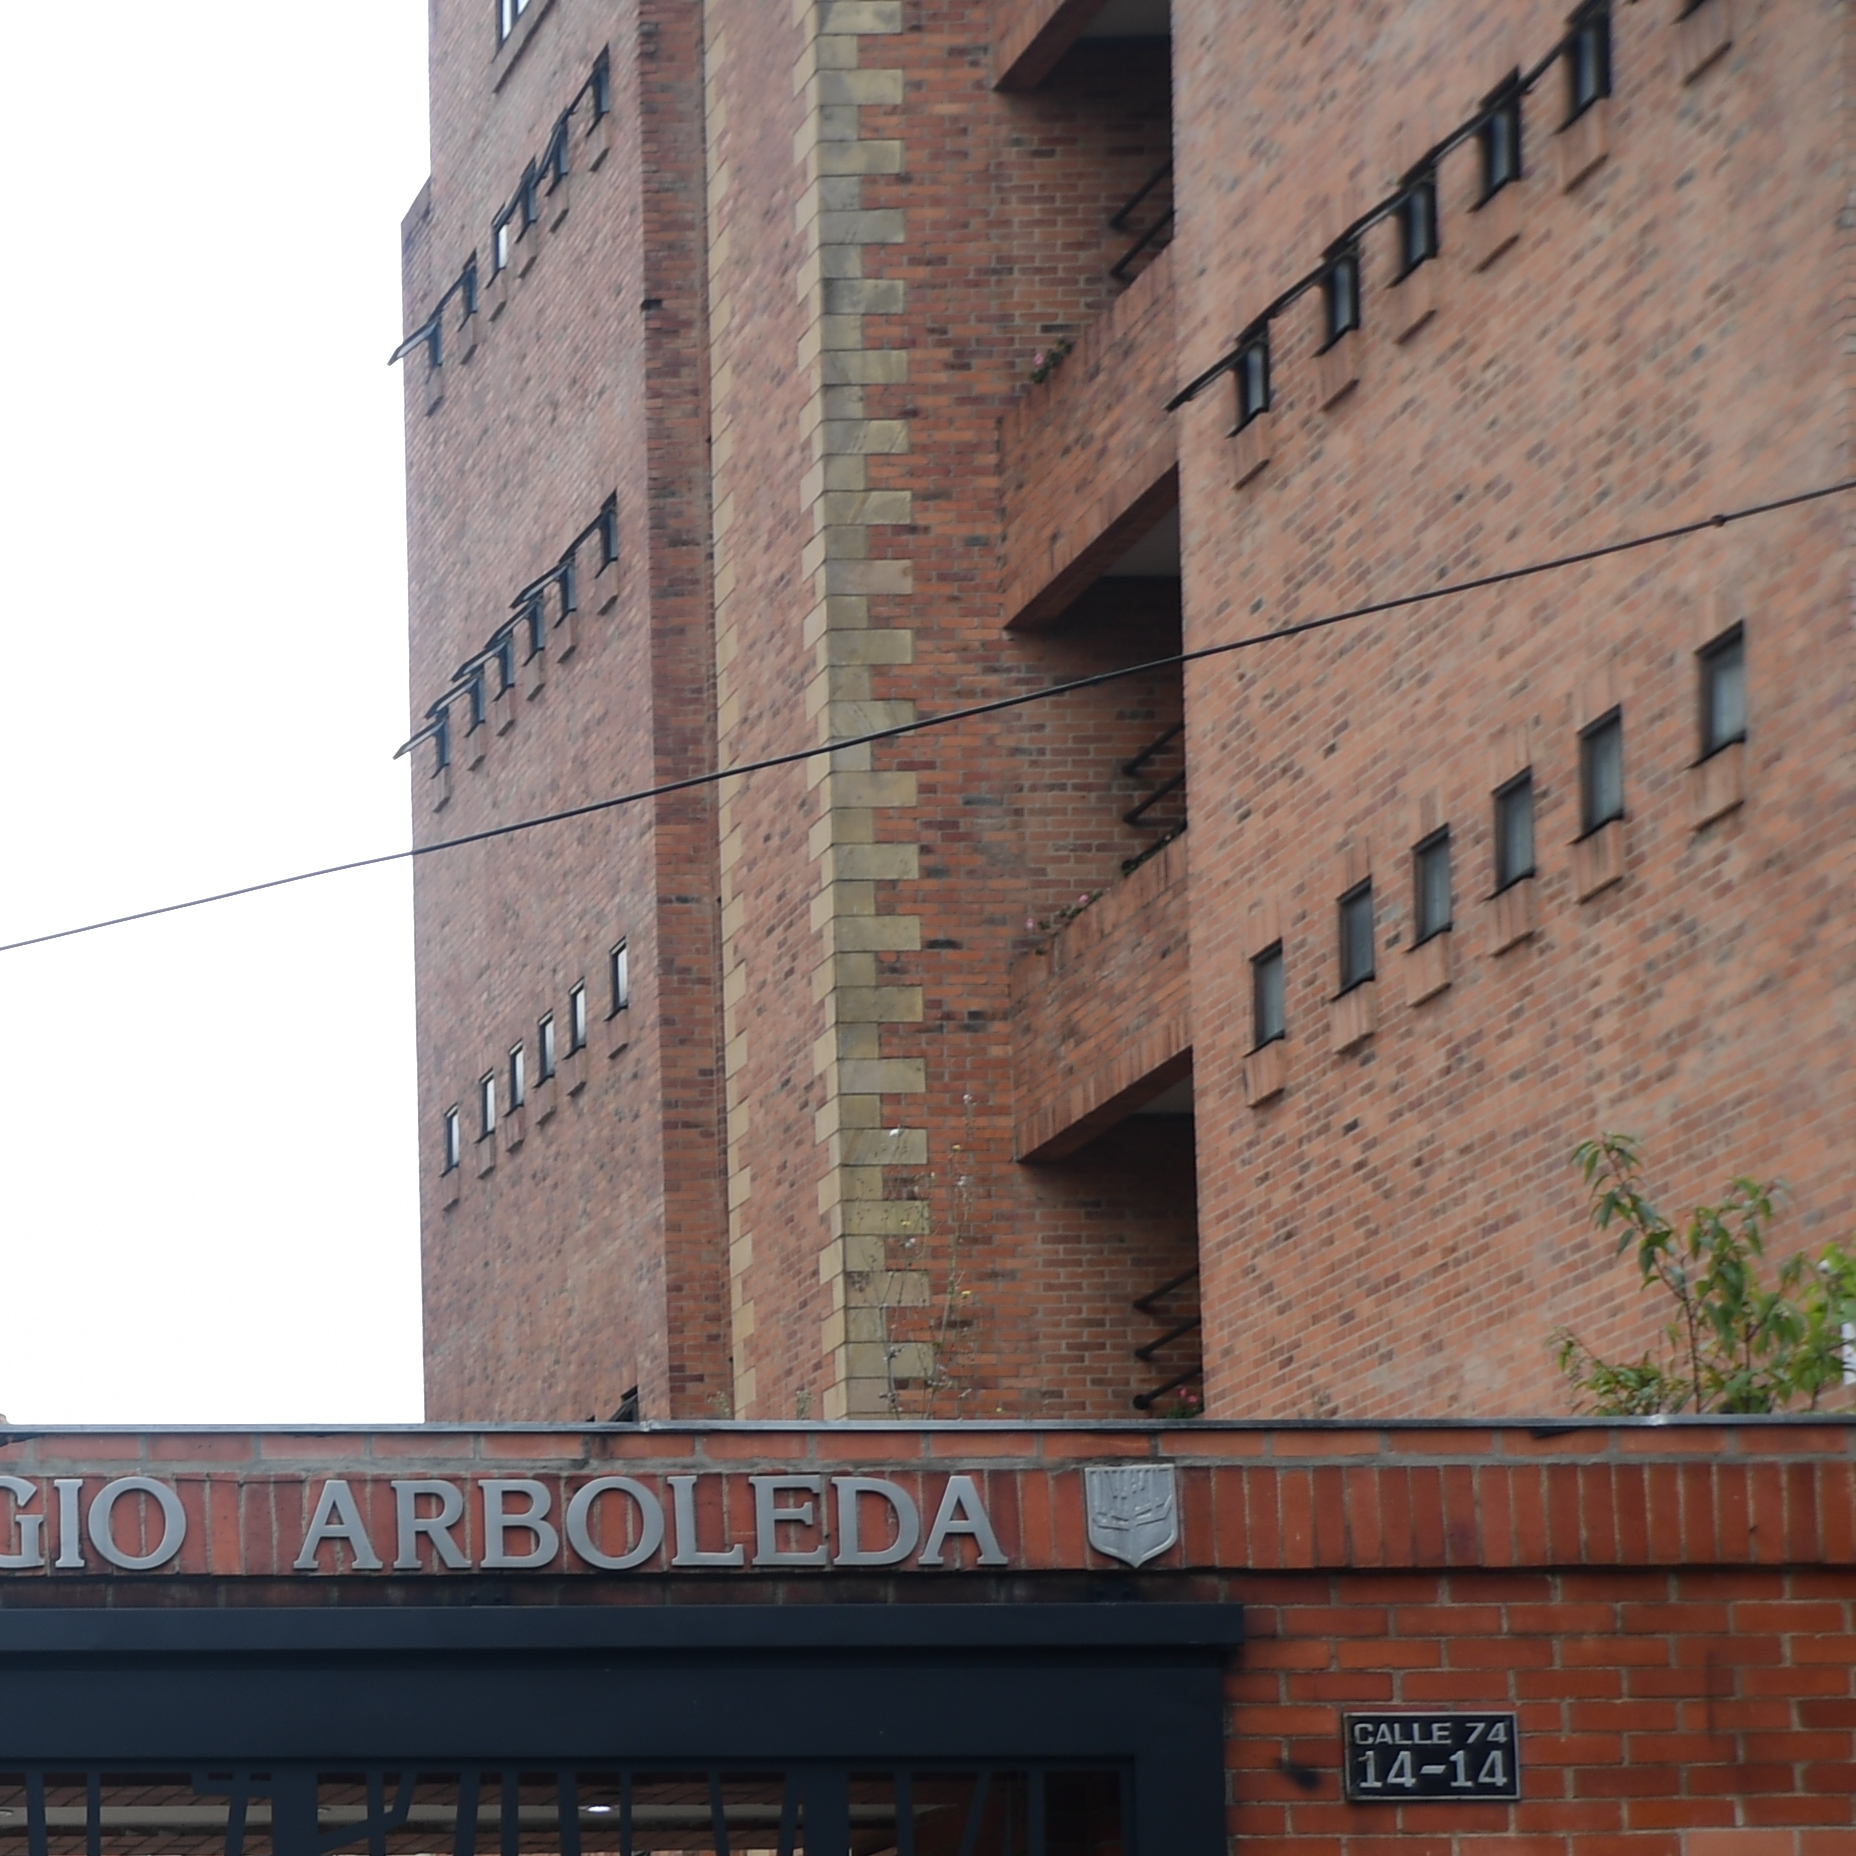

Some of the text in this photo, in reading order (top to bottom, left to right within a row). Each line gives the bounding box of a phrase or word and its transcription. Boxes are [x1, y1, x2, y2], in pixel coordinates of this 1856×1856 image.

[293, 1473, 1008, 1572] ARBOLEDA
[1353, 1721, 1509, 1745] CALLE 74
[1357, 1749, 1509, 1788] 14-14
